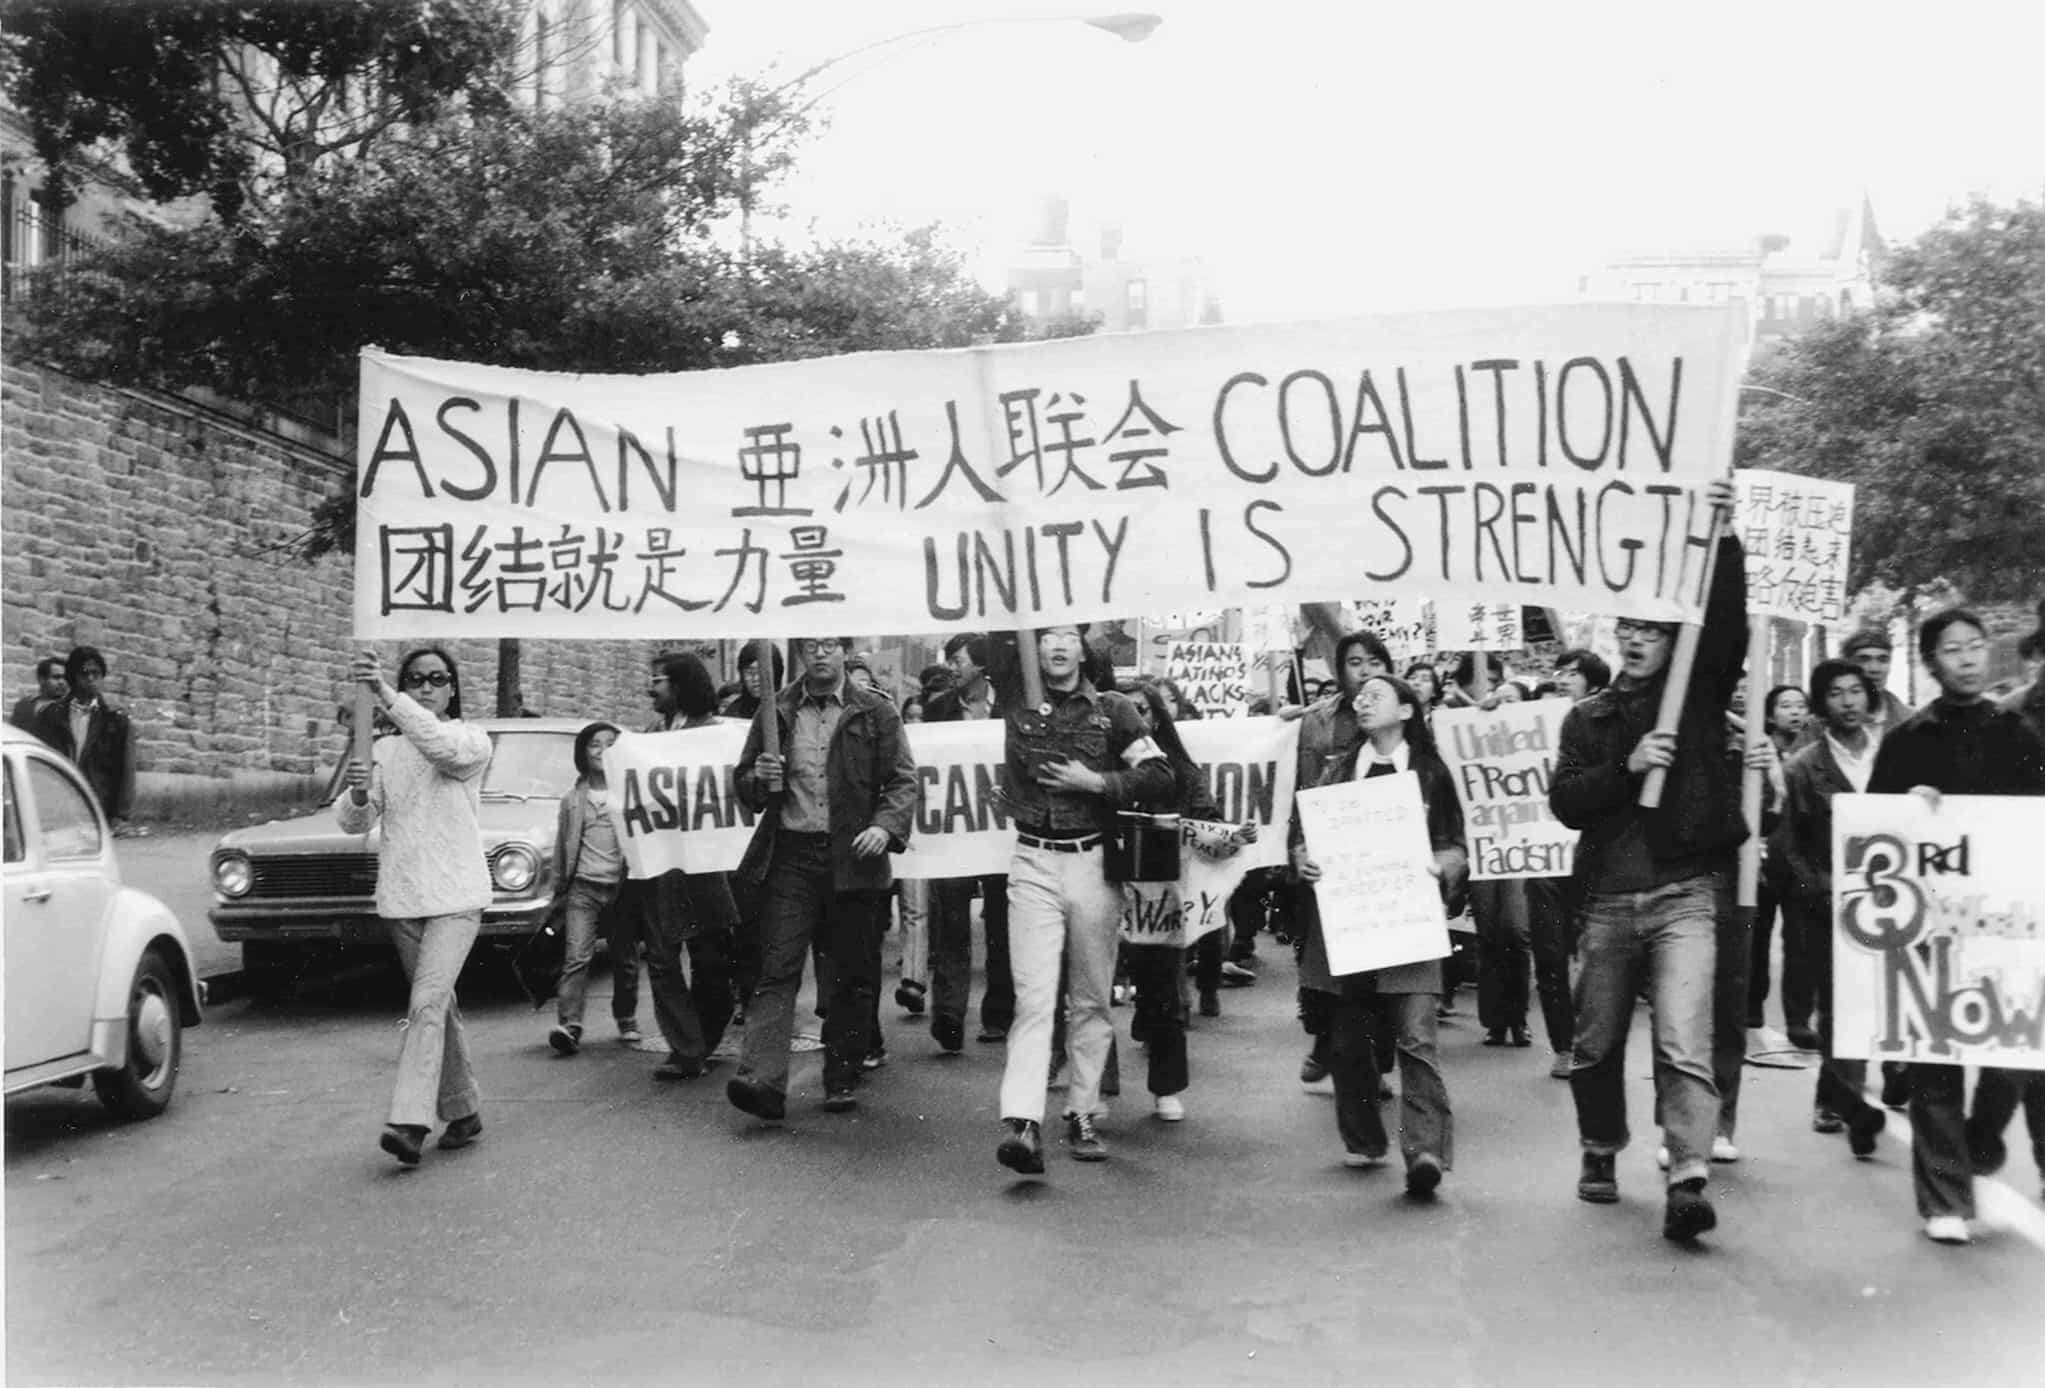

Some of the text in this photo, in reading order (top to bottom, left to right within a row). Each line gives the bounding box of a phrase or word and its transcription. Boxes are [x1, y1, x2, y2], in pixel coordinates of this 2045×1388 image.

[360, 396, 677, 512] ASIAN
[1214, 357, 1682, 483] COALITION
[379, 479, 1718, 620] 团结就是力量 UNITY IS STRENGTH
[1168, 662, 1246, 682] LATINOS
[1452, 715, 1549, 760] United
[624, 765, 756, 837] ASIAN
[1474, 837, 1569, 876] Facism
